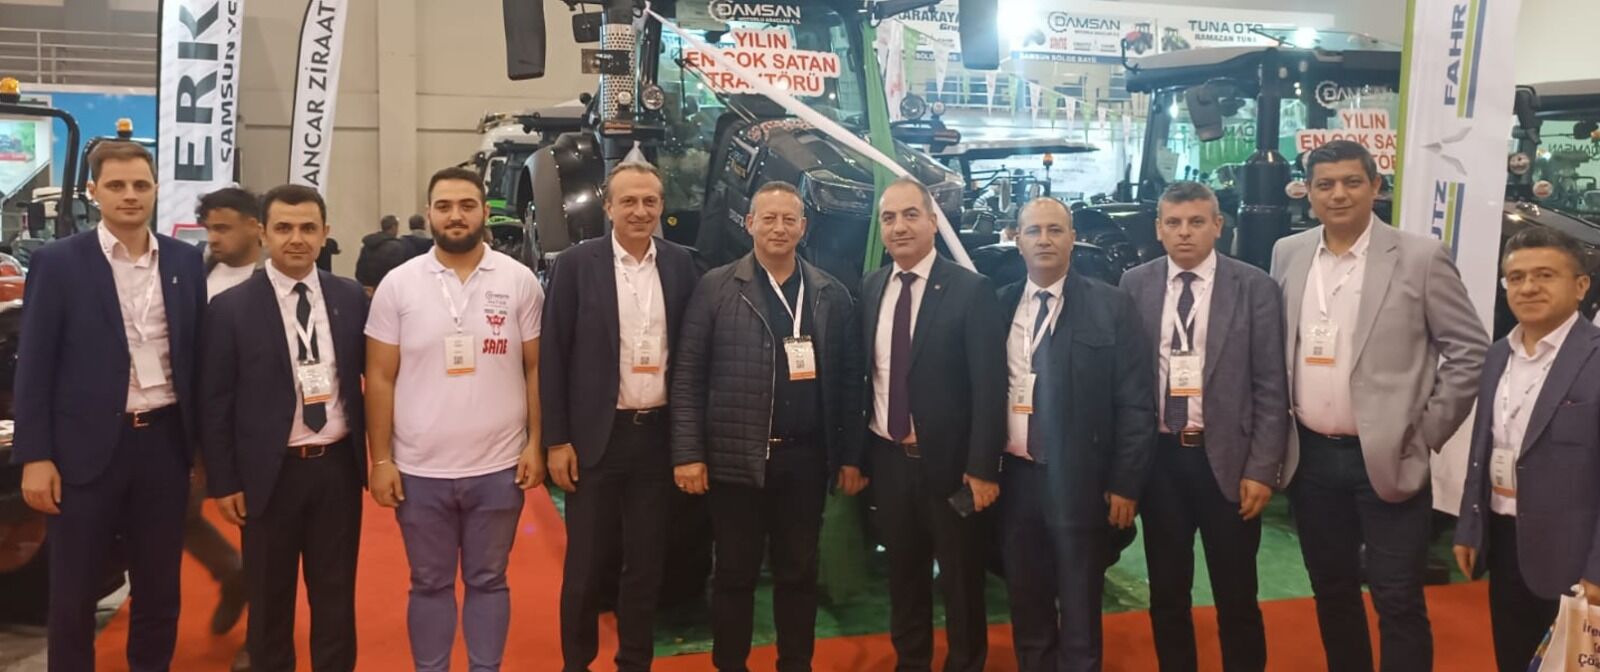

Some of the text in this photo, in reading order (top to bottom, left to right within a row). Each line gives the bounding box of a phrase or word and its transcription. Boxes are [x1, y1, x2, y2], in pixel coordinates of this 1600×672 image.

[898, 10, 959, 23] ARAKAY
[1188, 20, 1230, 32] TUNA
[940, 23, 960, 31] Gru
[735, 32, 787, 49] YILIN
[687, 52, 715, 67] EN
[773, 54, 836, 73] SATAN
[1444, 4, 1467, 105] FAHR
[707, 71, 820, 92] TRATÖRÜ
[220, 41, 236, 163] SAMSUN
[302, 0, 336, 186] ANCAR ZİRAAT
[1342, 112, 1387, 129] YILIN
[1300, 133, 1325, 149] EN
[1432, 180, 1447, 240] UTZ
